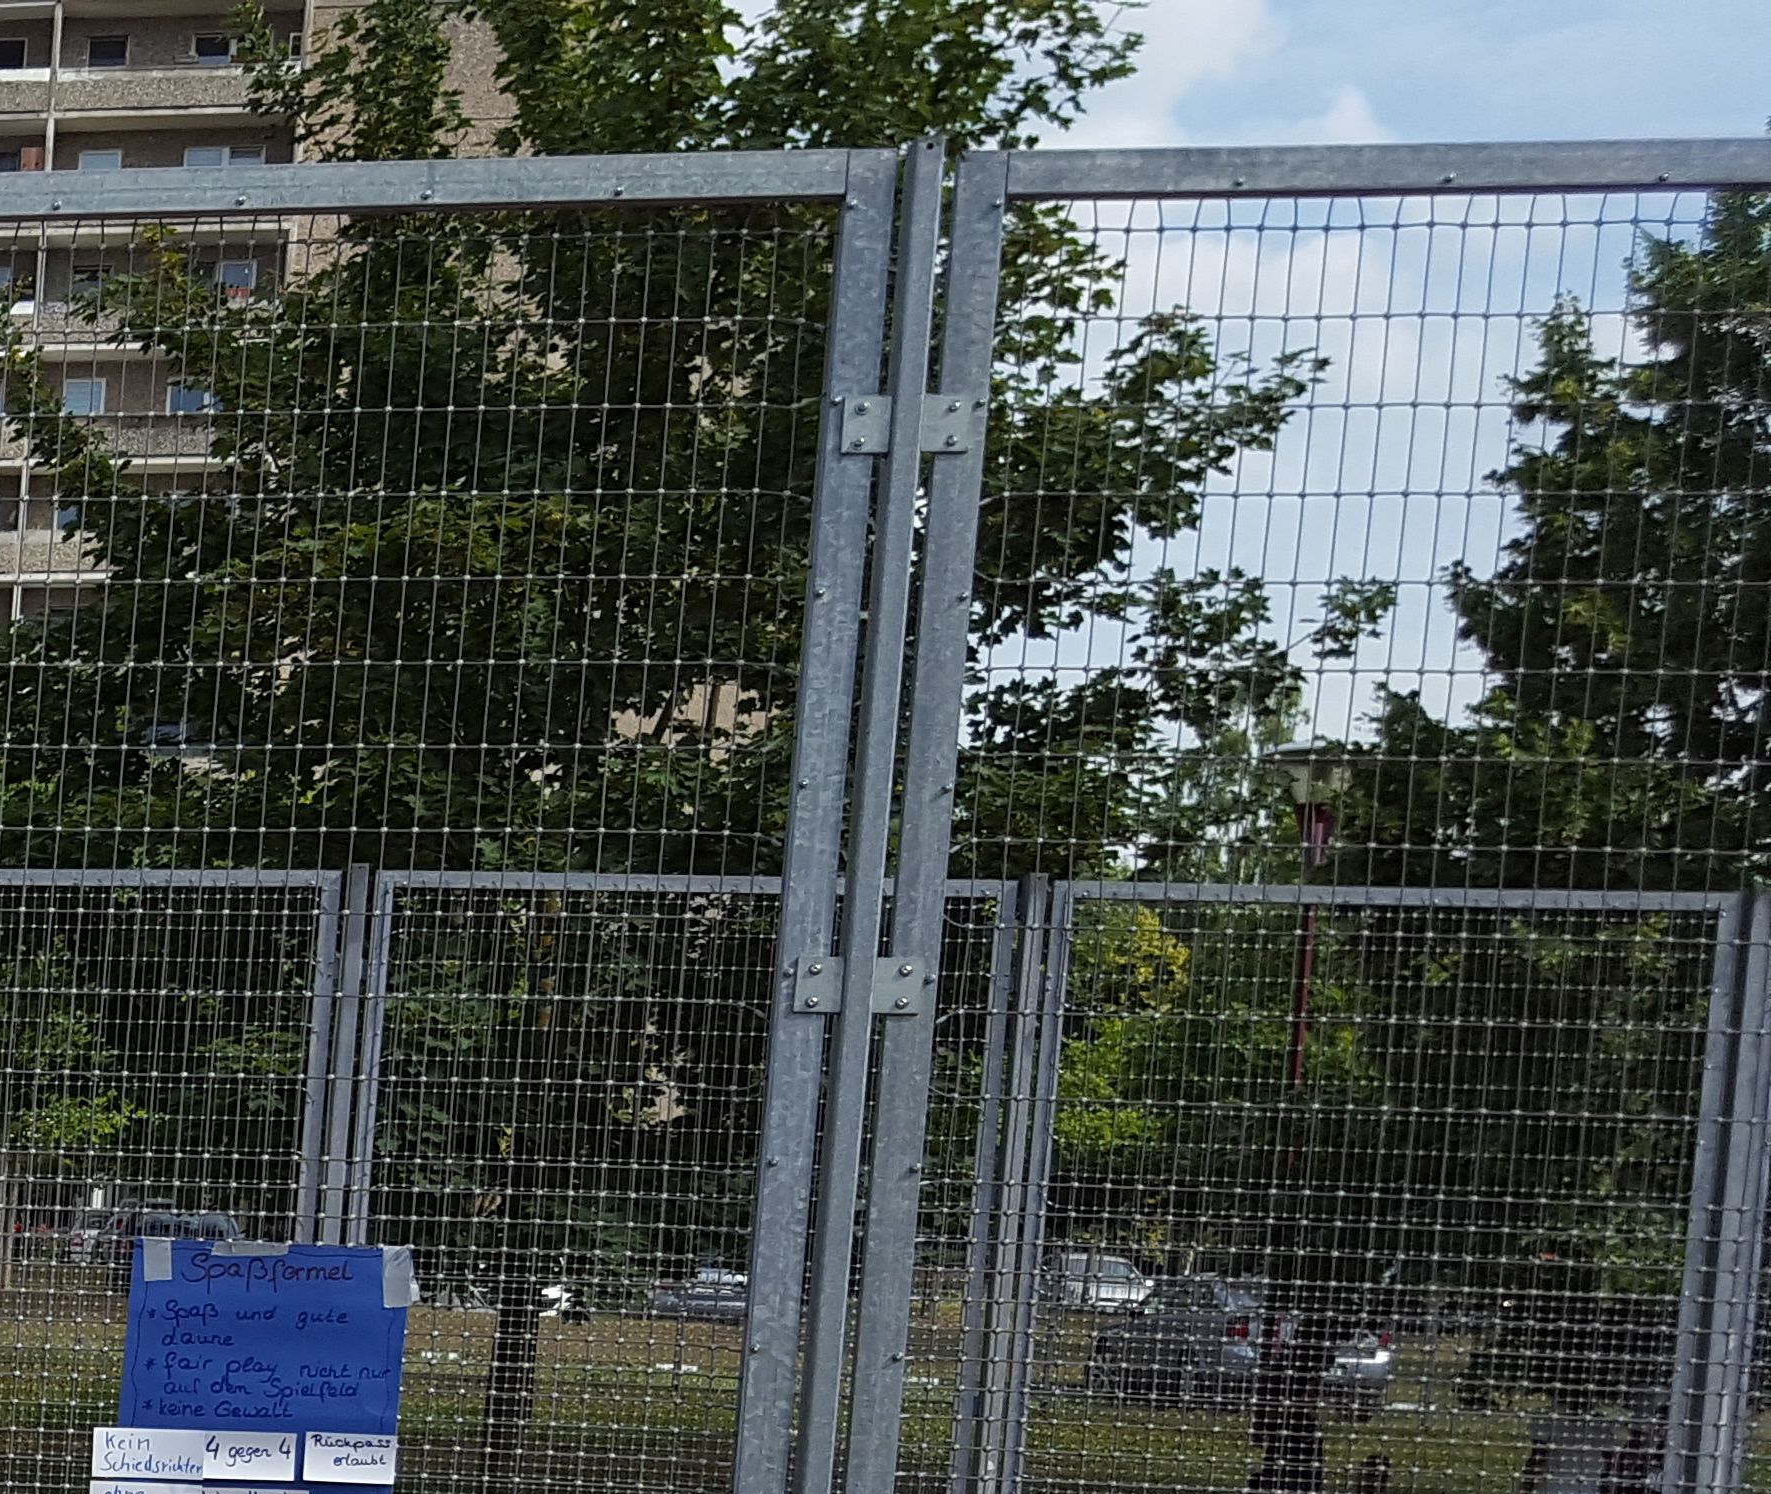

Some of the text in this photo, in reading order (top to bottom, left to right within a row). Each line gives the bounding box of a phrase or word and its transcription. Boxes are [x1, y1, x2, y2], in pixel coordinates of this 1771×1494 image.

[161, 1299, 349, 1331] Spaß und gute
[164, 1351, 392, 1384] fair play nicht nur
[210, 1375, 252, 1394] dem
[262, 1376, 360, 1406] Spielfeld
[214, 1400, 294, 1419] Gewalt
[105, 1431, 151, 1451] Kein
[205, 1435, 292, 1467] 4 gegen 4
[311, 1434, 391, 1453] Rückpass
[333, 1452, 387, 1467] erlaubt
